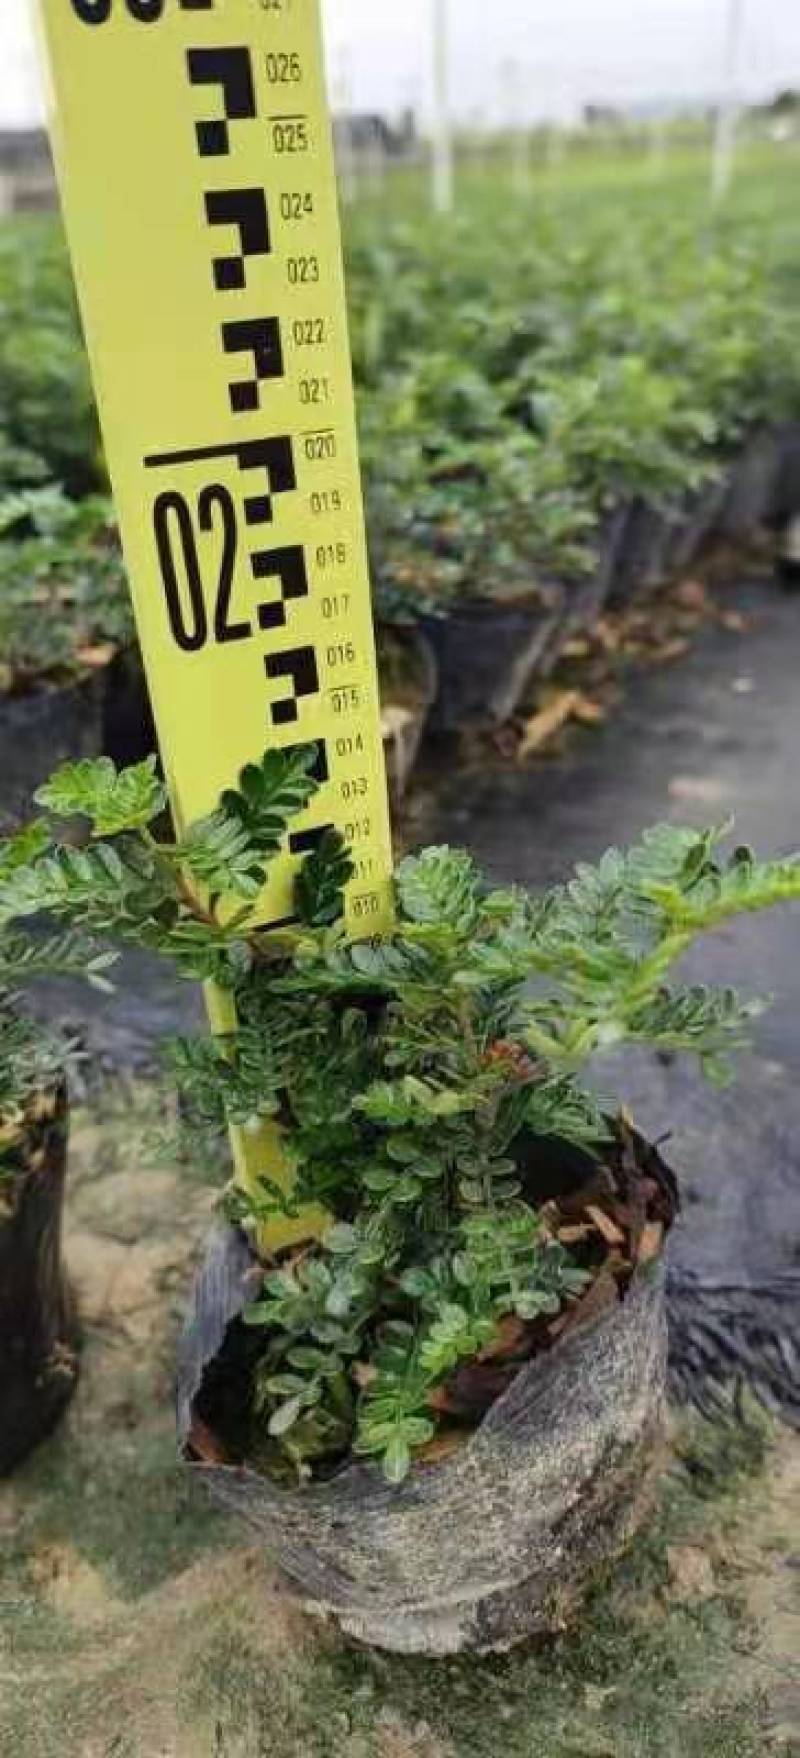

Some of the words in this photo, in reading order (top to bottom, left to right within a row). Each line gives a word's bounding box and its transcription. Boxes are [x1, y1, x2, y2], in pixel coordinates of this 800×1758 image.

[265, 52, 302, 82] 026
[273, 124, 309, 153] 025
[280, 192, 313, 220] 024
[287, 257, 319, 283] 023
[293, 320, 325, 346] 022
[299, 379, 330, 404] 021
[305, 434, 335, 459] 020
[311, 490, 341, 513] 019
[154, 483, 251, 651] 02
[316, 543, 346, 566] 018
[322, 595, 349, 618] 017
[327, 643, 355, 667] 016
[332, 691, 360, 713] 015
[336, 735, 363, 757] 014
[341, 777, 368, 799] 013
